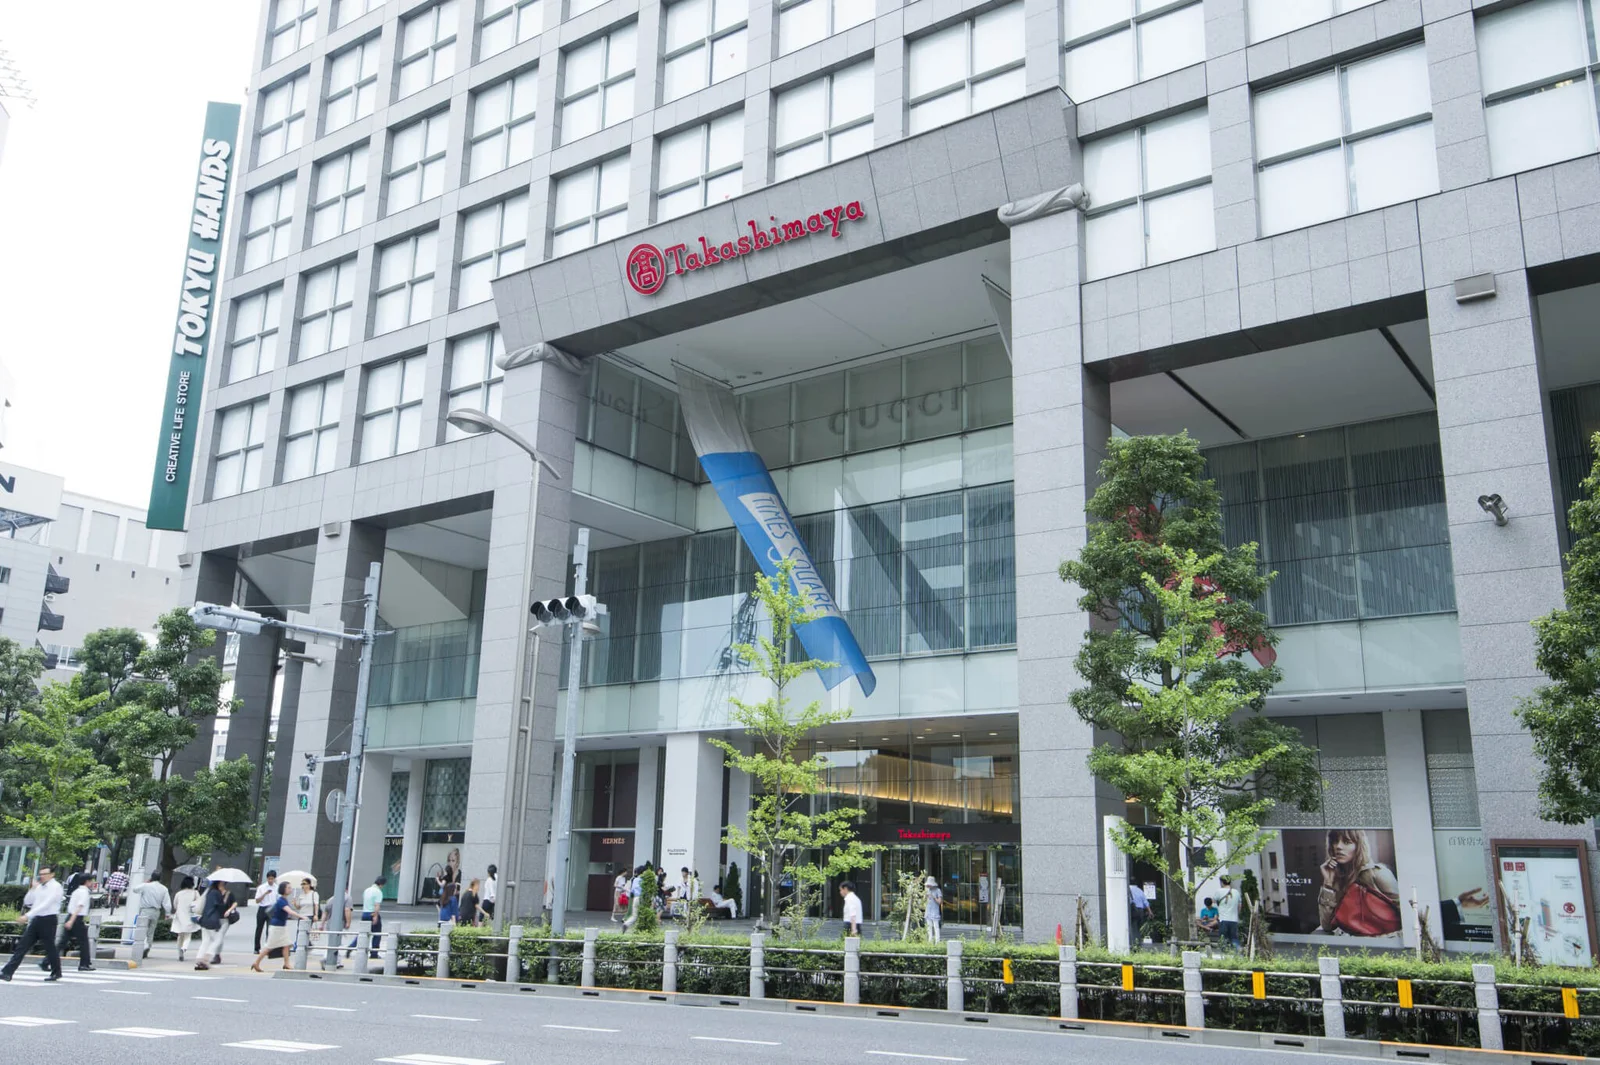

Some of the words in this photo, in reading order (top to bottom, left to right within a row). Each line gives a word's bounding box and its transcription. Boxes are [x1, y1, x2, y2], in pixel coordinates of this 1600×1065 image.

[192, 138, 231, 241] HANDS
[665, 200, 865, 275] Takashimaya
[174, 248, 216, 356] TOKYU
[173, 407, 185, 430] LIFE
[176, 371, 190, 404] STORE
[165, 433, 181, 482] CREATIVE
[752, 497, 795, 539] TIMES
[787, 547, 837, 613] SQUARE
